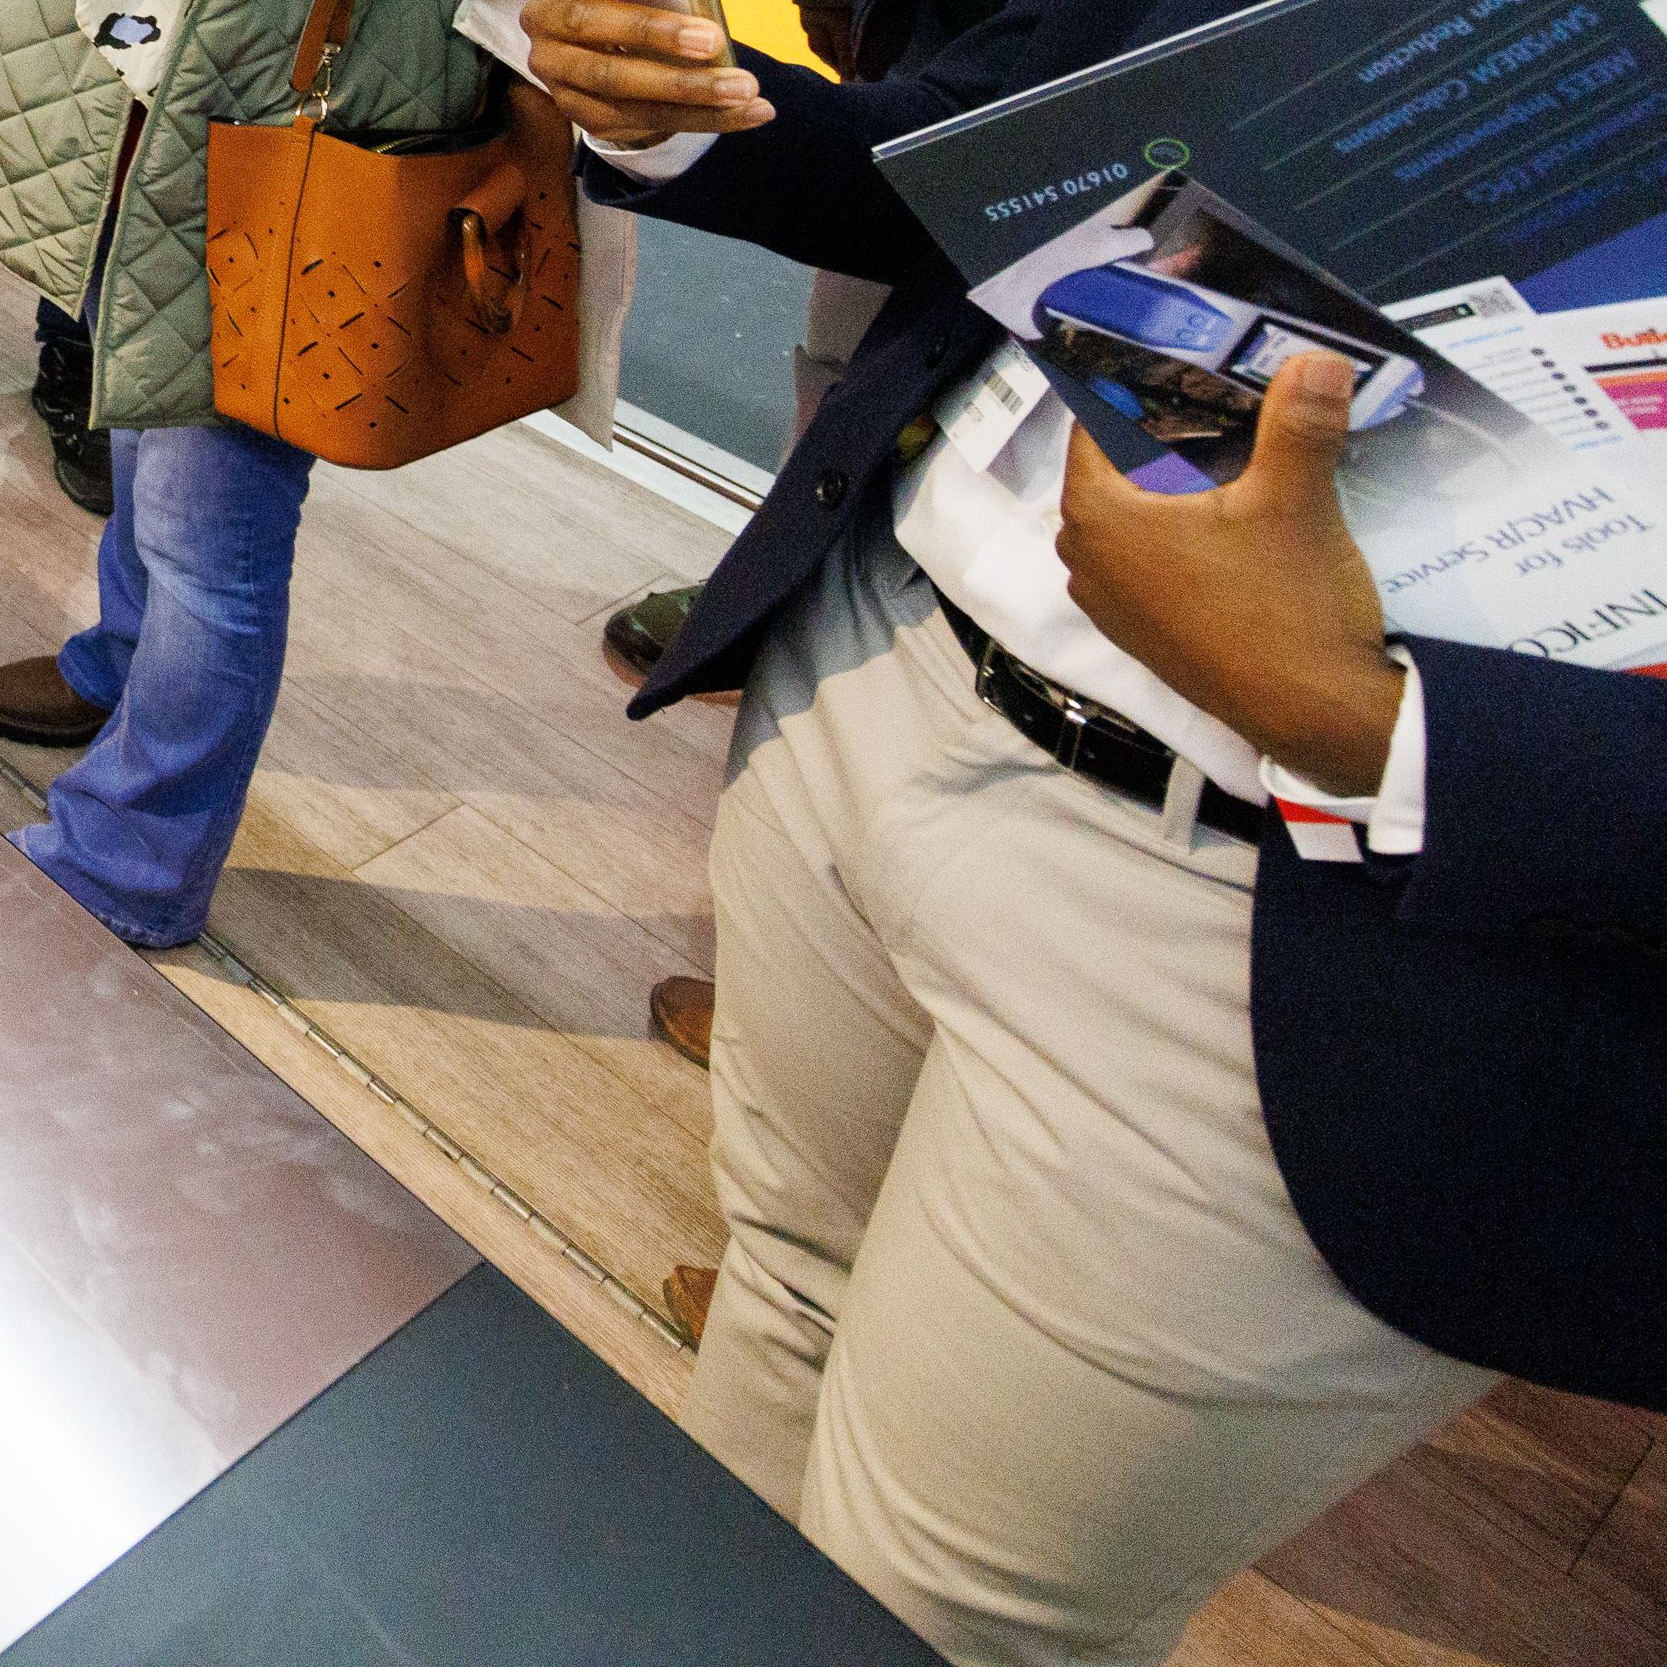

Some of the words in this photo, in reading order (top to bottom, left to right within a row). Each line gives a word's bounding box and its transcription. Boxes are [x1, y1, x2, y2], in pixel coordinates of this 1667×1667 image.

[1356, 12, 1473, 87] Reduction
[1334, 76, 1468, 158] Calculations
[1061, 161, 1128, 196] 01670
[983, 185, 1058, 222] 541555
[1487, 484, 1614, 550] HVAC/R
[1560, 512, 1653, 552] Tools
[1382, 540, 1490, 589] Service
[1513, 548, 1564, 576] for
